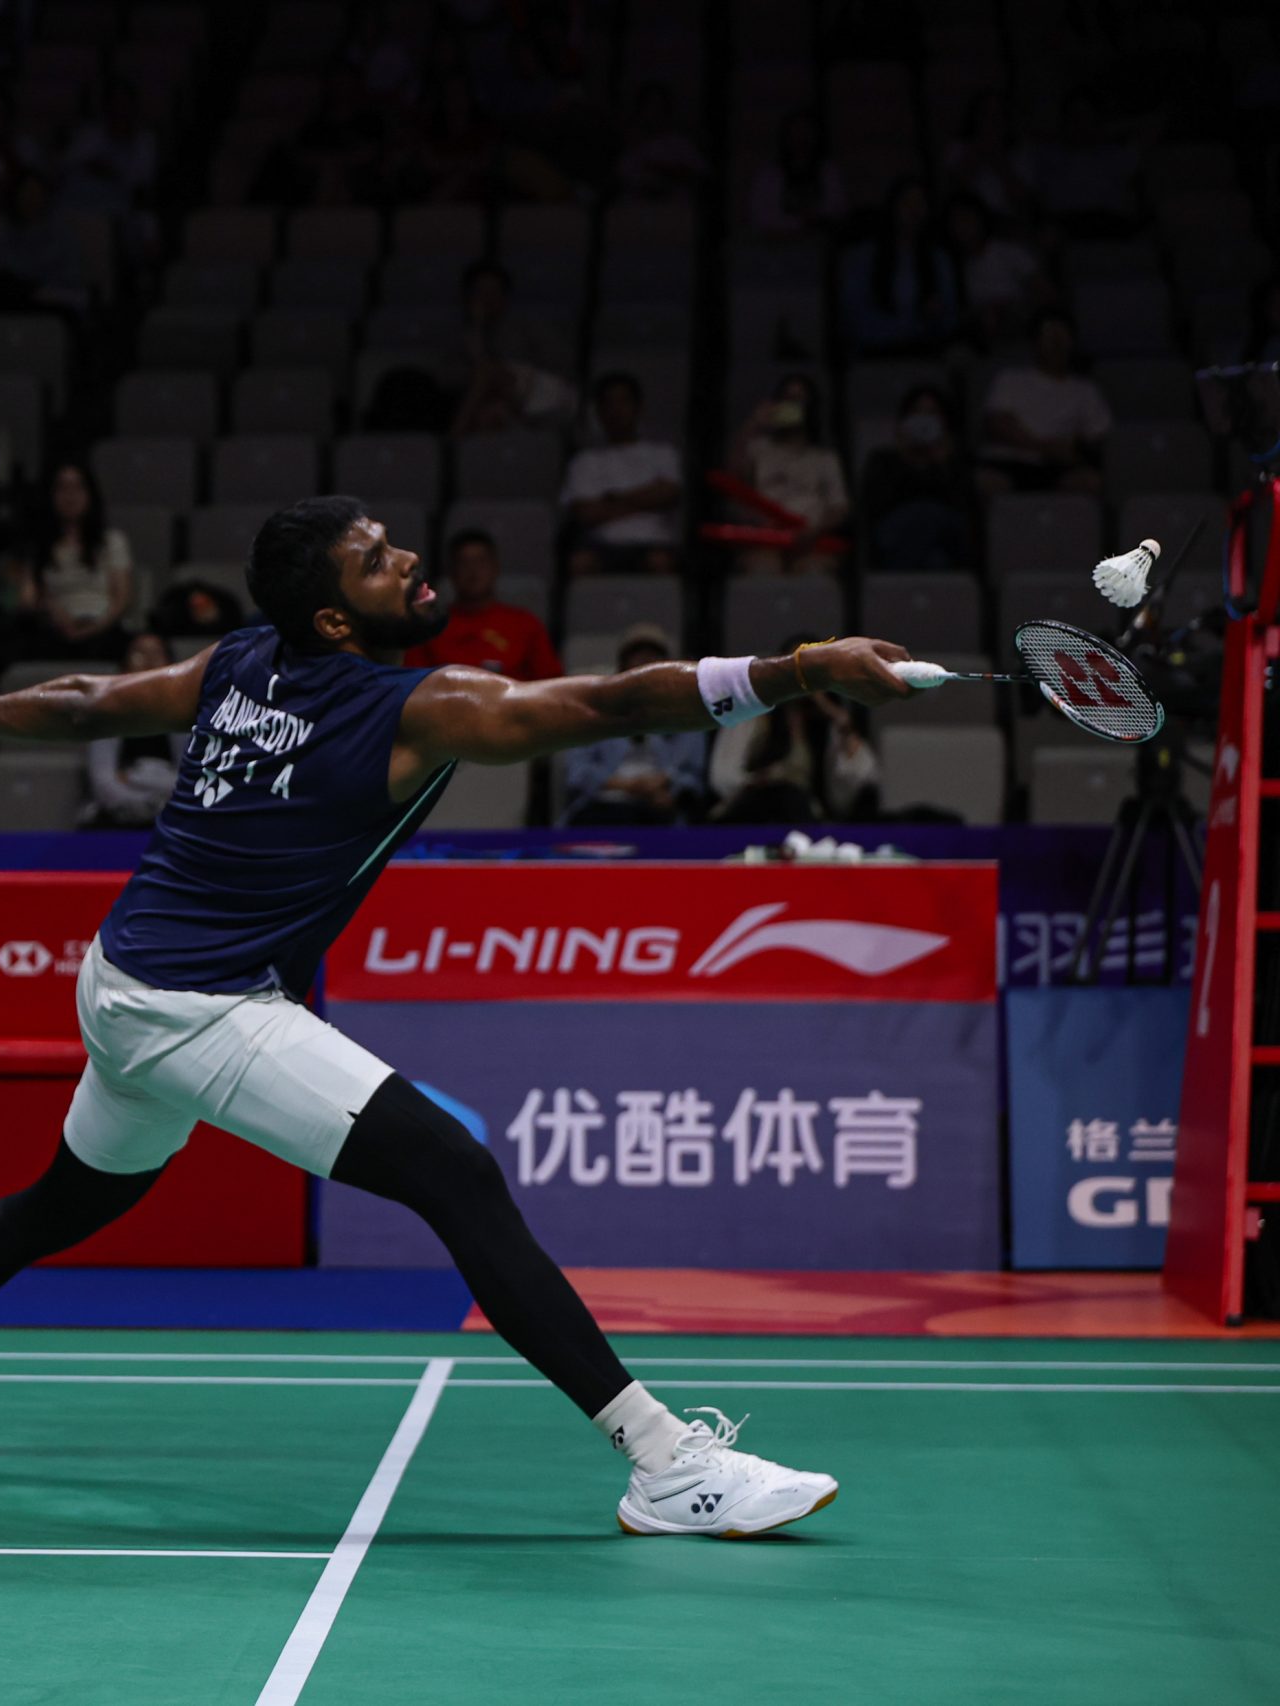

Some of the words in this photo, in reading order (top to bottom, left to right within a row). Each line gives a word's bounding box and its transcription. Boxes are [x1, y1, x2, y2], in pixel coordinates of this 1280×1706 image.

[365, 927, 681, 975] LI-NING
[506, 1088, 922, 1188] 优酷体育
